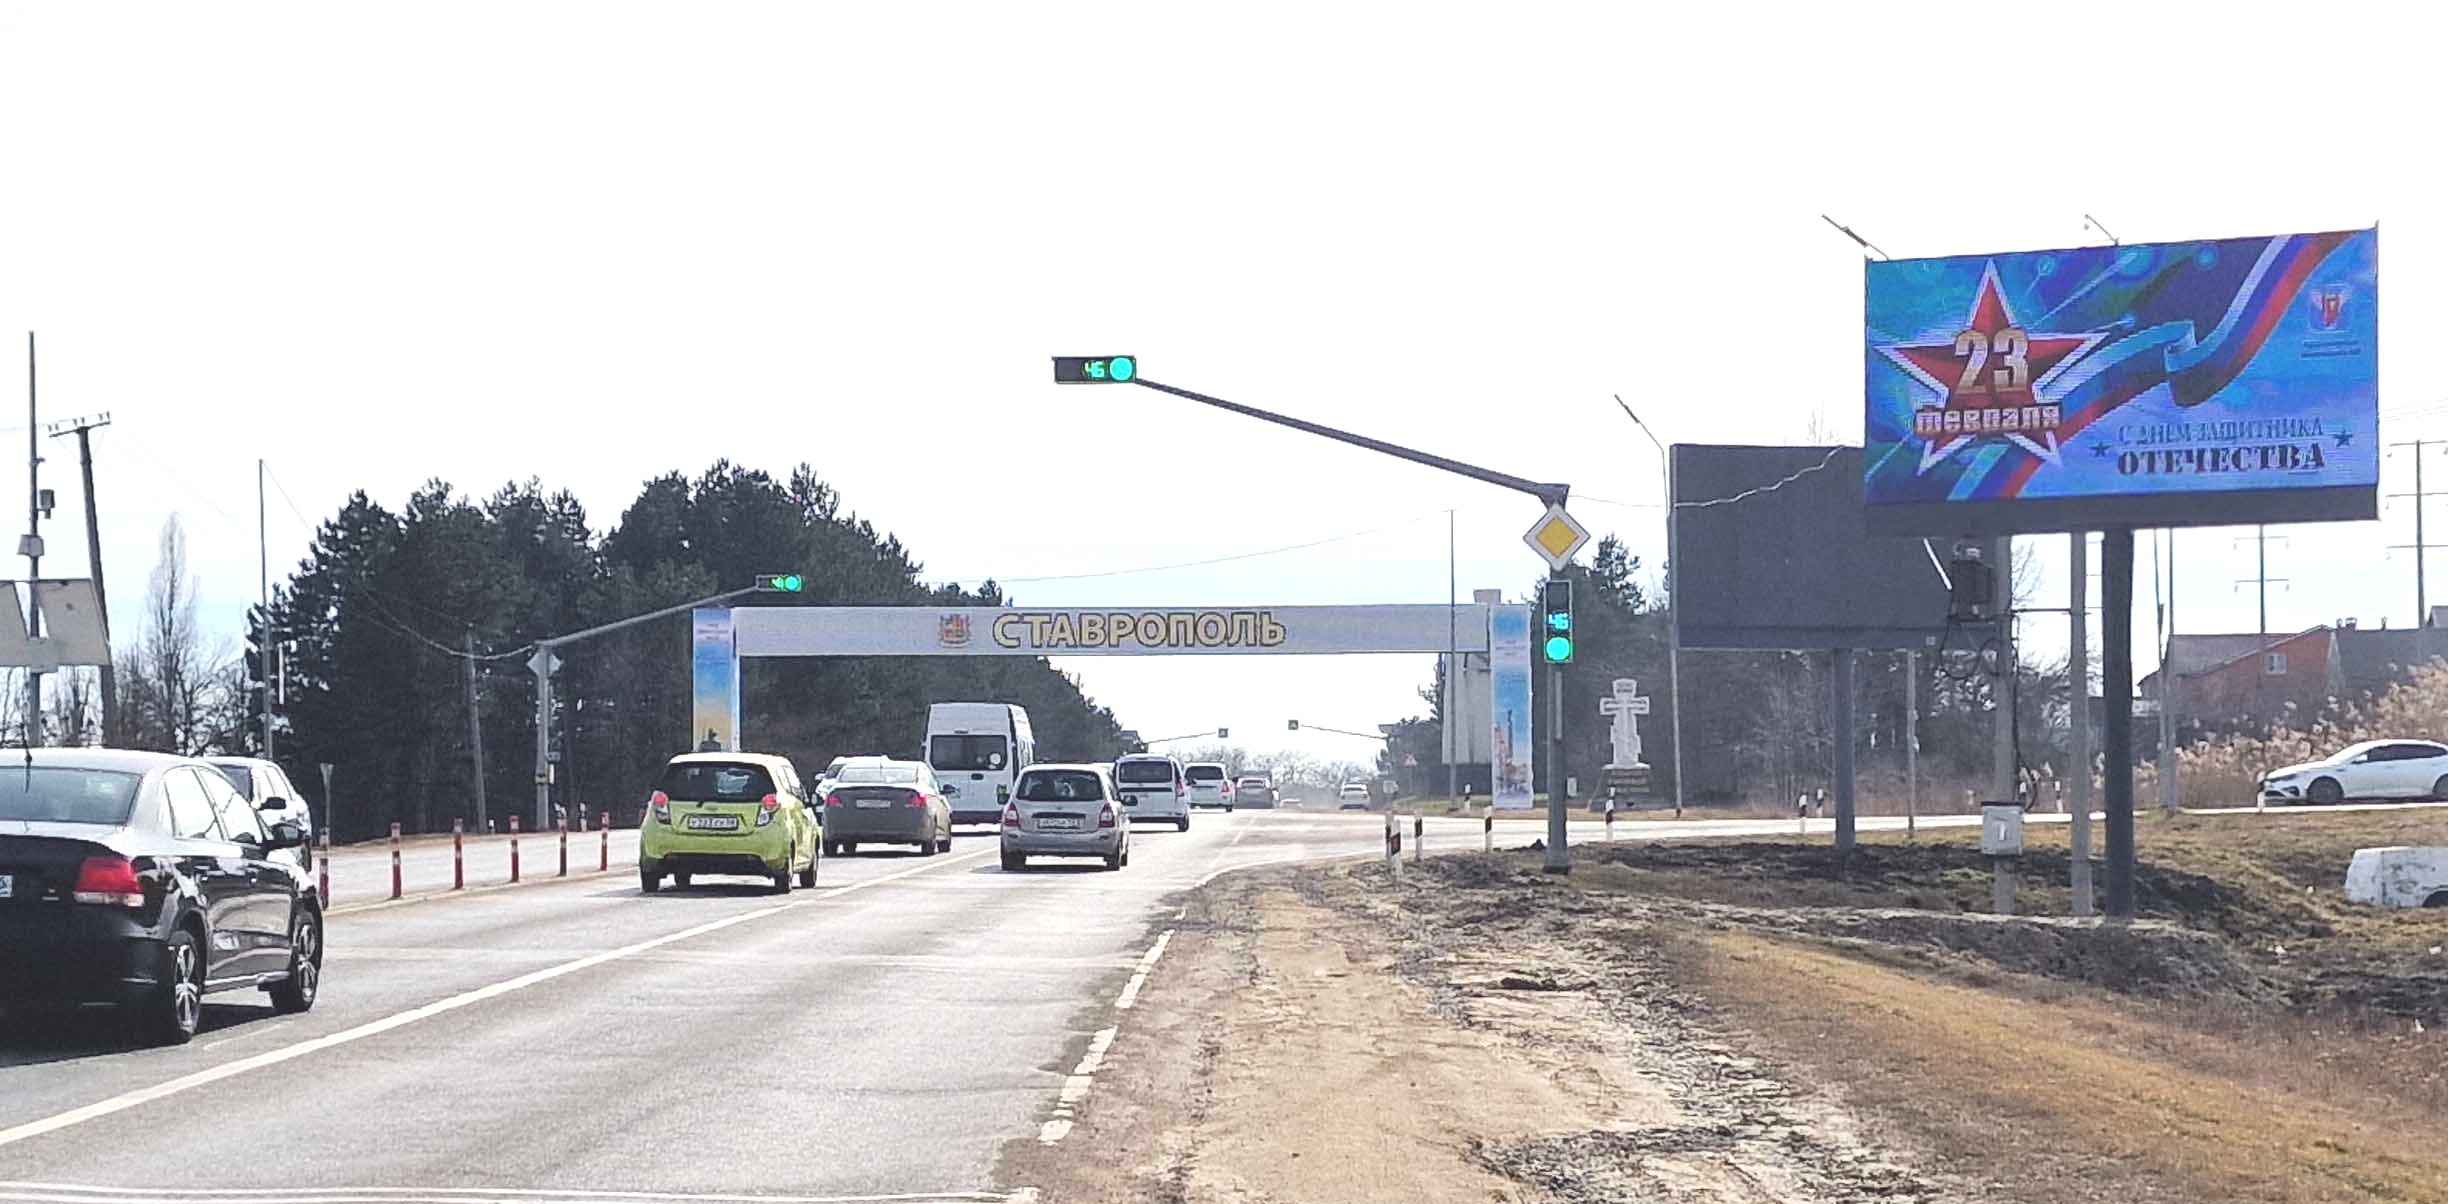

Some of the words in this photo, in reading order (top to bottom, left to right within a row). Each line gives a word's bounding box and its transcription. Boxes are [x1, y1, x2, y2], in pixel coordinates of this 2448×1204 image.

[1955, 328, 2029, 394] 23
[2199, 417, 2324, 443] ЗАЩИТНИКА
[2117, 442, 2325, 475] ОТЕЧЕСТВА
[992, 612, 1286, 648] СТАВРОПОЛЬ
